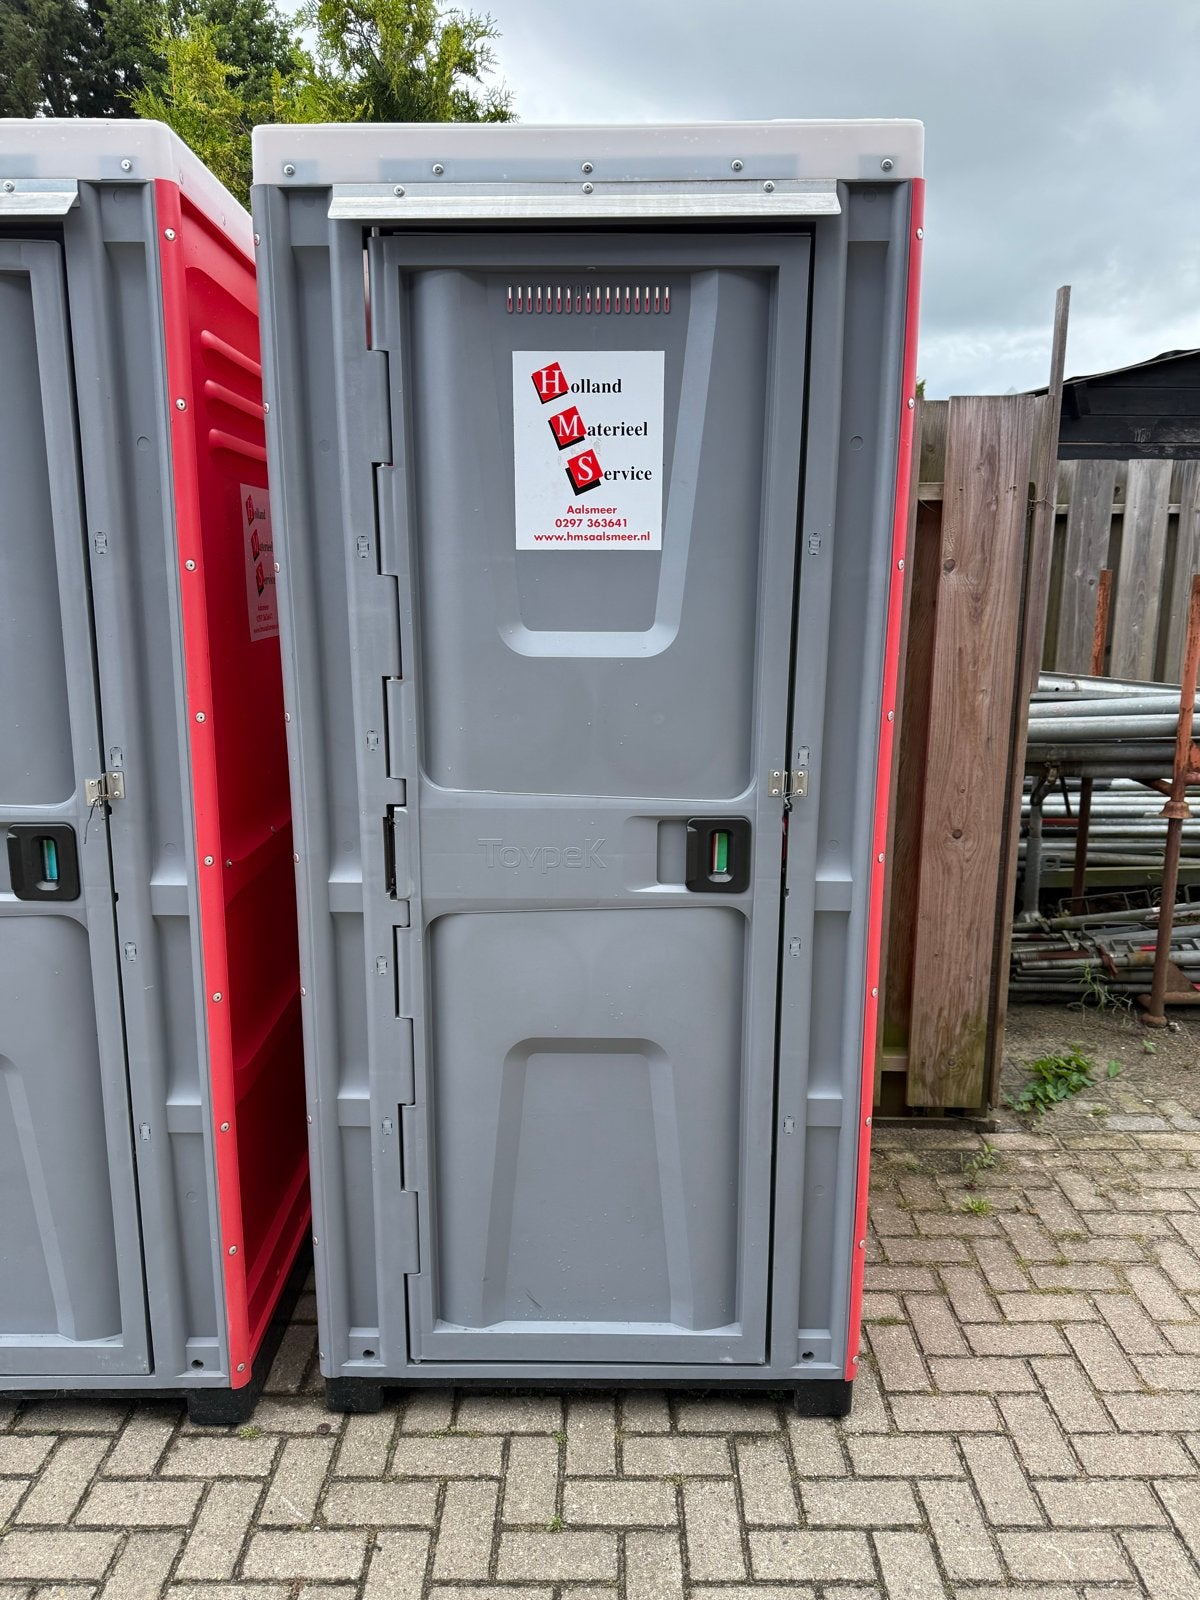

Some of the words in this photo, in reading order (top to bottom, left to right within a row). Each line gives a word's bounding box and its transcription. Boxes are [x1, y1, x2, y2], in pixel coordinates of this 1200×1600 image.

[540, 370, 621, 393] Holland
[558, 415, 648, 436] Materieel
[578, 456, 652, 480] Service
[566, 505, 617, 514] Aalsmeer
[555, 519, 583, 528] 0297
[587, 519, 627, 528] 363641
[534, 532, 650, 541] www.hmsaalsmeer.nl
